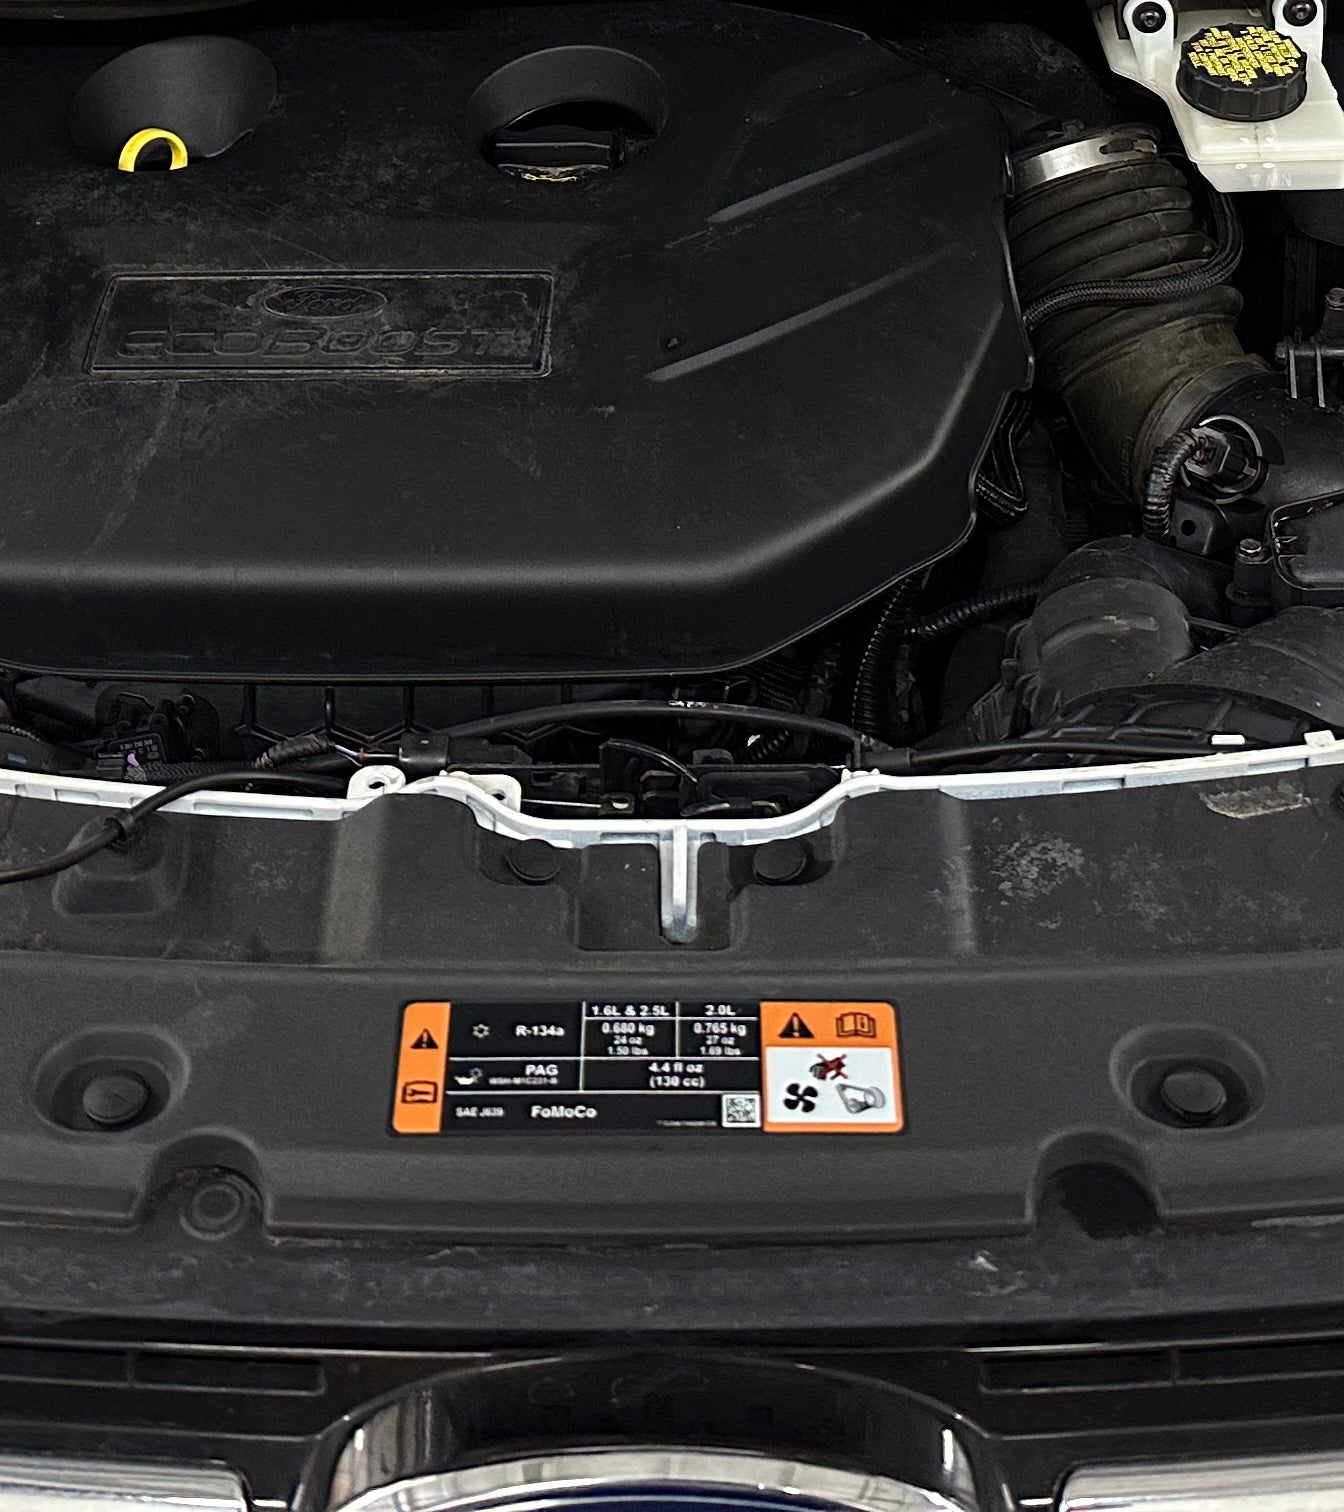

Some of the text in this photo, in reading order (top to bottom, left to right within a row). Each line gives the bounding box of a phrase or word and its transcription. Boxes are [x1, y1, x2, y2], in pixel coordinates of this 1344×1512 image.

[282, 288, 367, 315] Ford
[591, 1005, 670, 1016] 1.6L & 2.5L
[704, 1004, 736, 1016] 2.0L
[515, 1025, 565, 1037] R-134a
[601, 1022, 655, 1036] 0.680 kg
[693, 1022, 747, 1036] 0.765 kg
[612, 1035, 643, 1045] 24 oz
[705, 1035, 735, 1045] 27 oz
[631, 1046, 649, 1055] lbs
[723, 1046, 741, 1056] lbs
[525, 1064, 559, 1076] PAG
[648, 1062, 704, 1073] 4.4 fl oz
[649, 1075, 705, 1088] (130 cc)
[456, 1107, 478, 1118] SAE
[530, 1105, 598, 1119] FoMoCo
